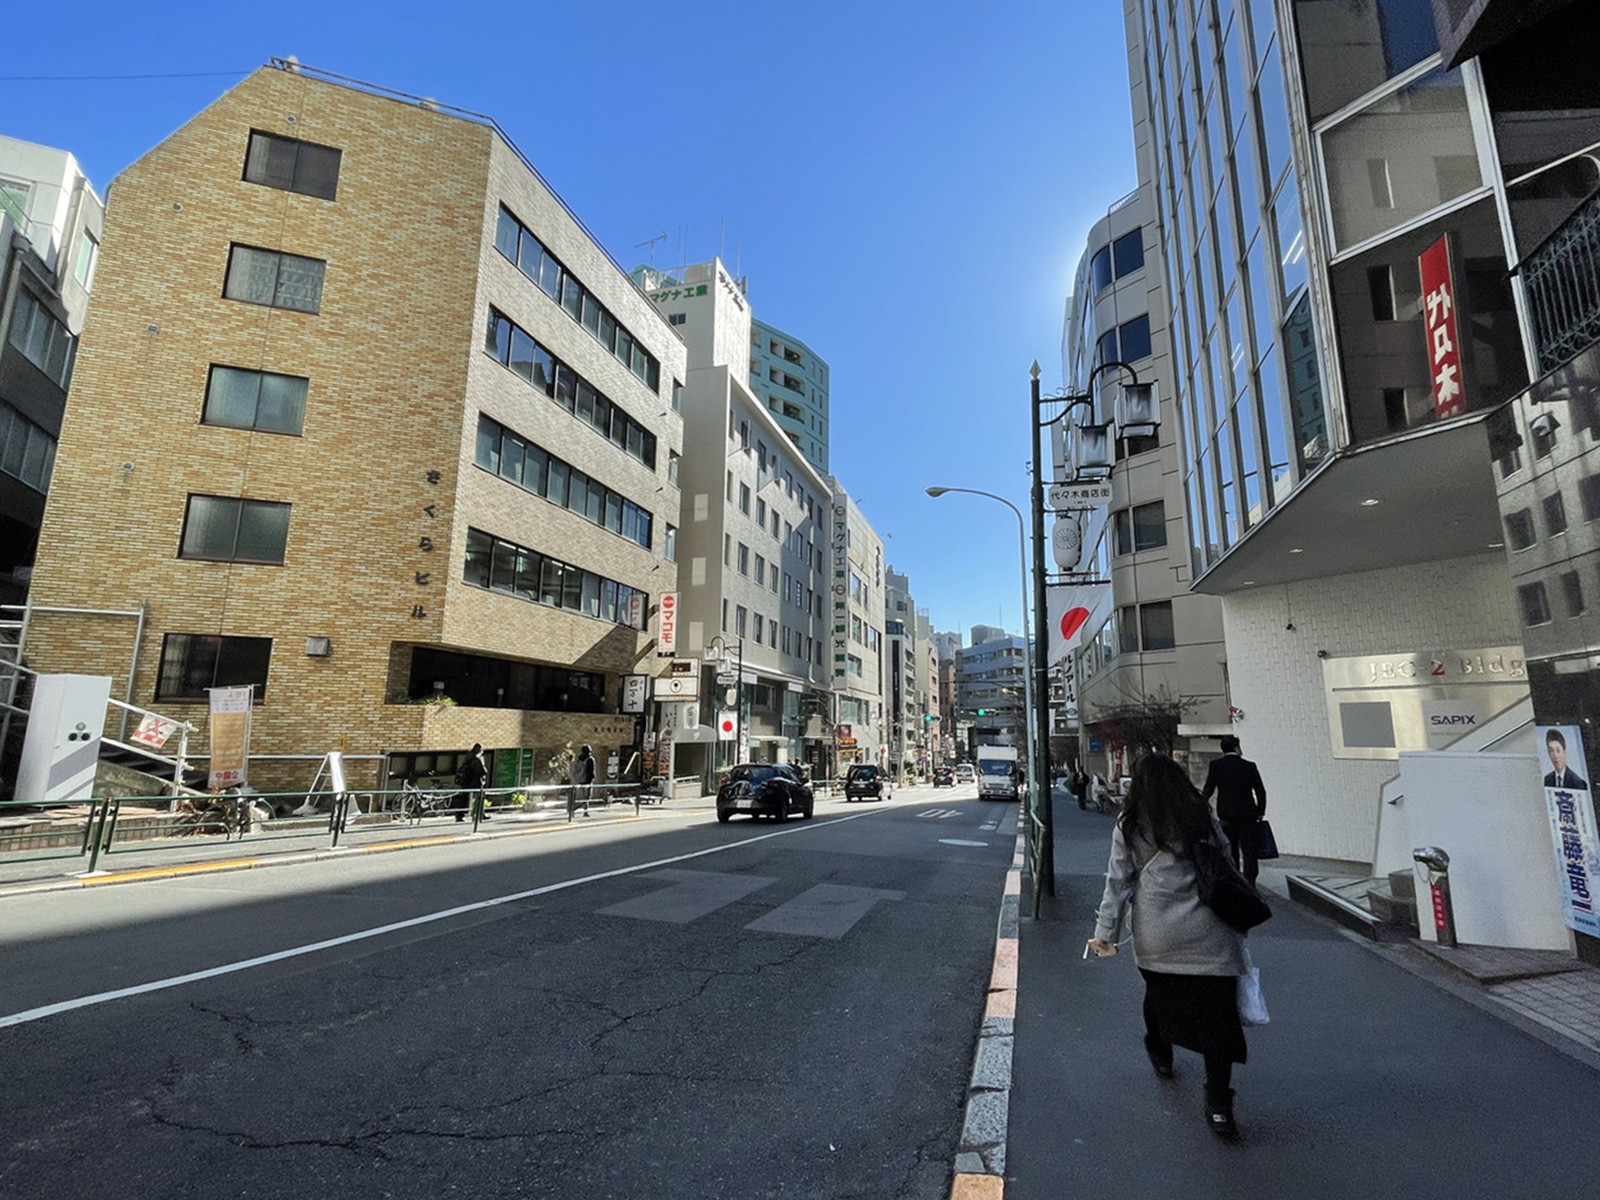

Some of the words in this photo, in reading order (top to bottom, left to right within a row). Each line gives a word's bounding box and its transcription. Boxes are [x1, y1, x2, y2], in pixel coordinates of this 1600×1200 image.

[1051, 488, 1110, 500] 代々木商店街
[661, 610, 674, 643] マコモ
[1370, 660, 1416, 683] JEC
[1430, 659, 1445, 676] 2
[1458, 655, 1524, 678] Bldg
[1430, 715, 1476, 725] SAPIX
